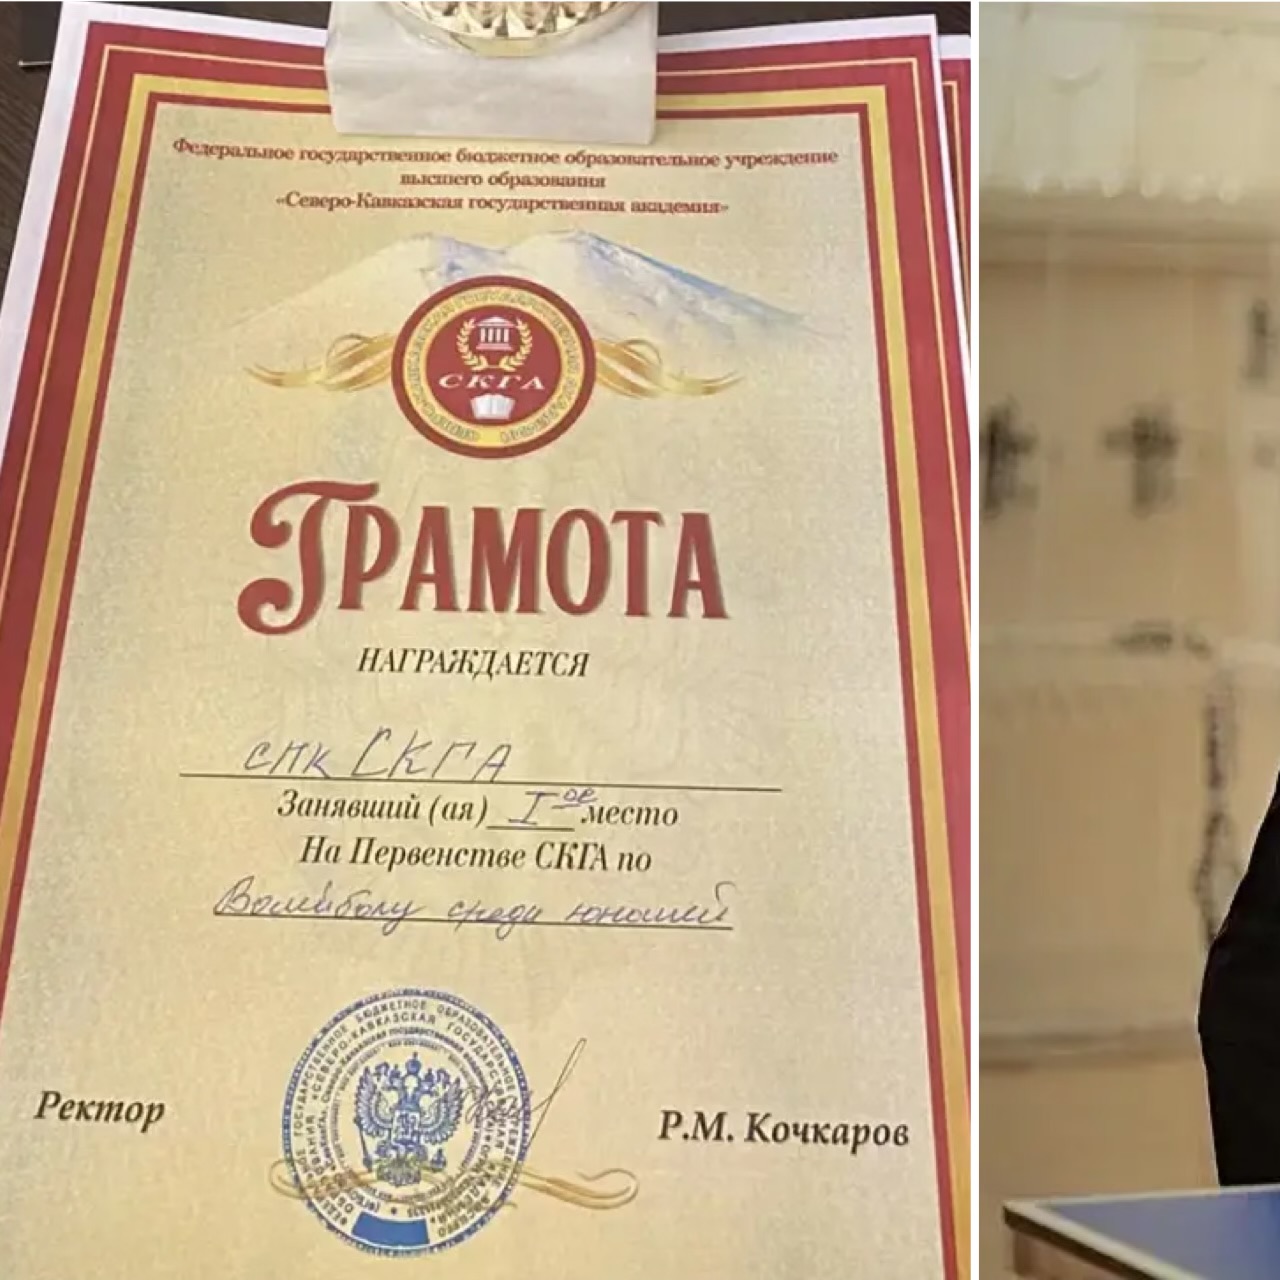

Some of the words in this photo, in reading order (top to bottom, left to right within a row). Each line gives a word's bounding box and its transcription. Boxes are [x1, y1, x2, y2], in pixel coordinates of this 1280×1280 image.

[173, 139, 294, 161] Федеральное
[300, 148, 451, 165] государственное
[456, 148, 560, 166] бюджетное
[565, 149, 720, 168] образовательное
[724, 149, 839, 169] учреждение
[400, 173, 483, 187] высшего
[487, 171, 606, 189] образования
[468, 198, 625, 214] государственная
[439, 374, 545, 390] СКГА
[237, 480, 731, 635] ГРАМОТА
[357, 646, 590, 680] НАГРАЖДАЕТСЯ
[277, 788, 422, 821] Занявший
[428, 793, 489, 826] (ая)
[580, 799, 679, 828] место
[299, 836, 342, 864] На
[349, 836, 527, 872] Первенстве
[535, 841, 609, 871] СКГА
[616, 850, 653, 872] по
[35, 1090, 165, 1126] Ректор
[659, 1109, 734, 1142] Р.М.
[745, 1111, 910, 1148] Кочкаров
